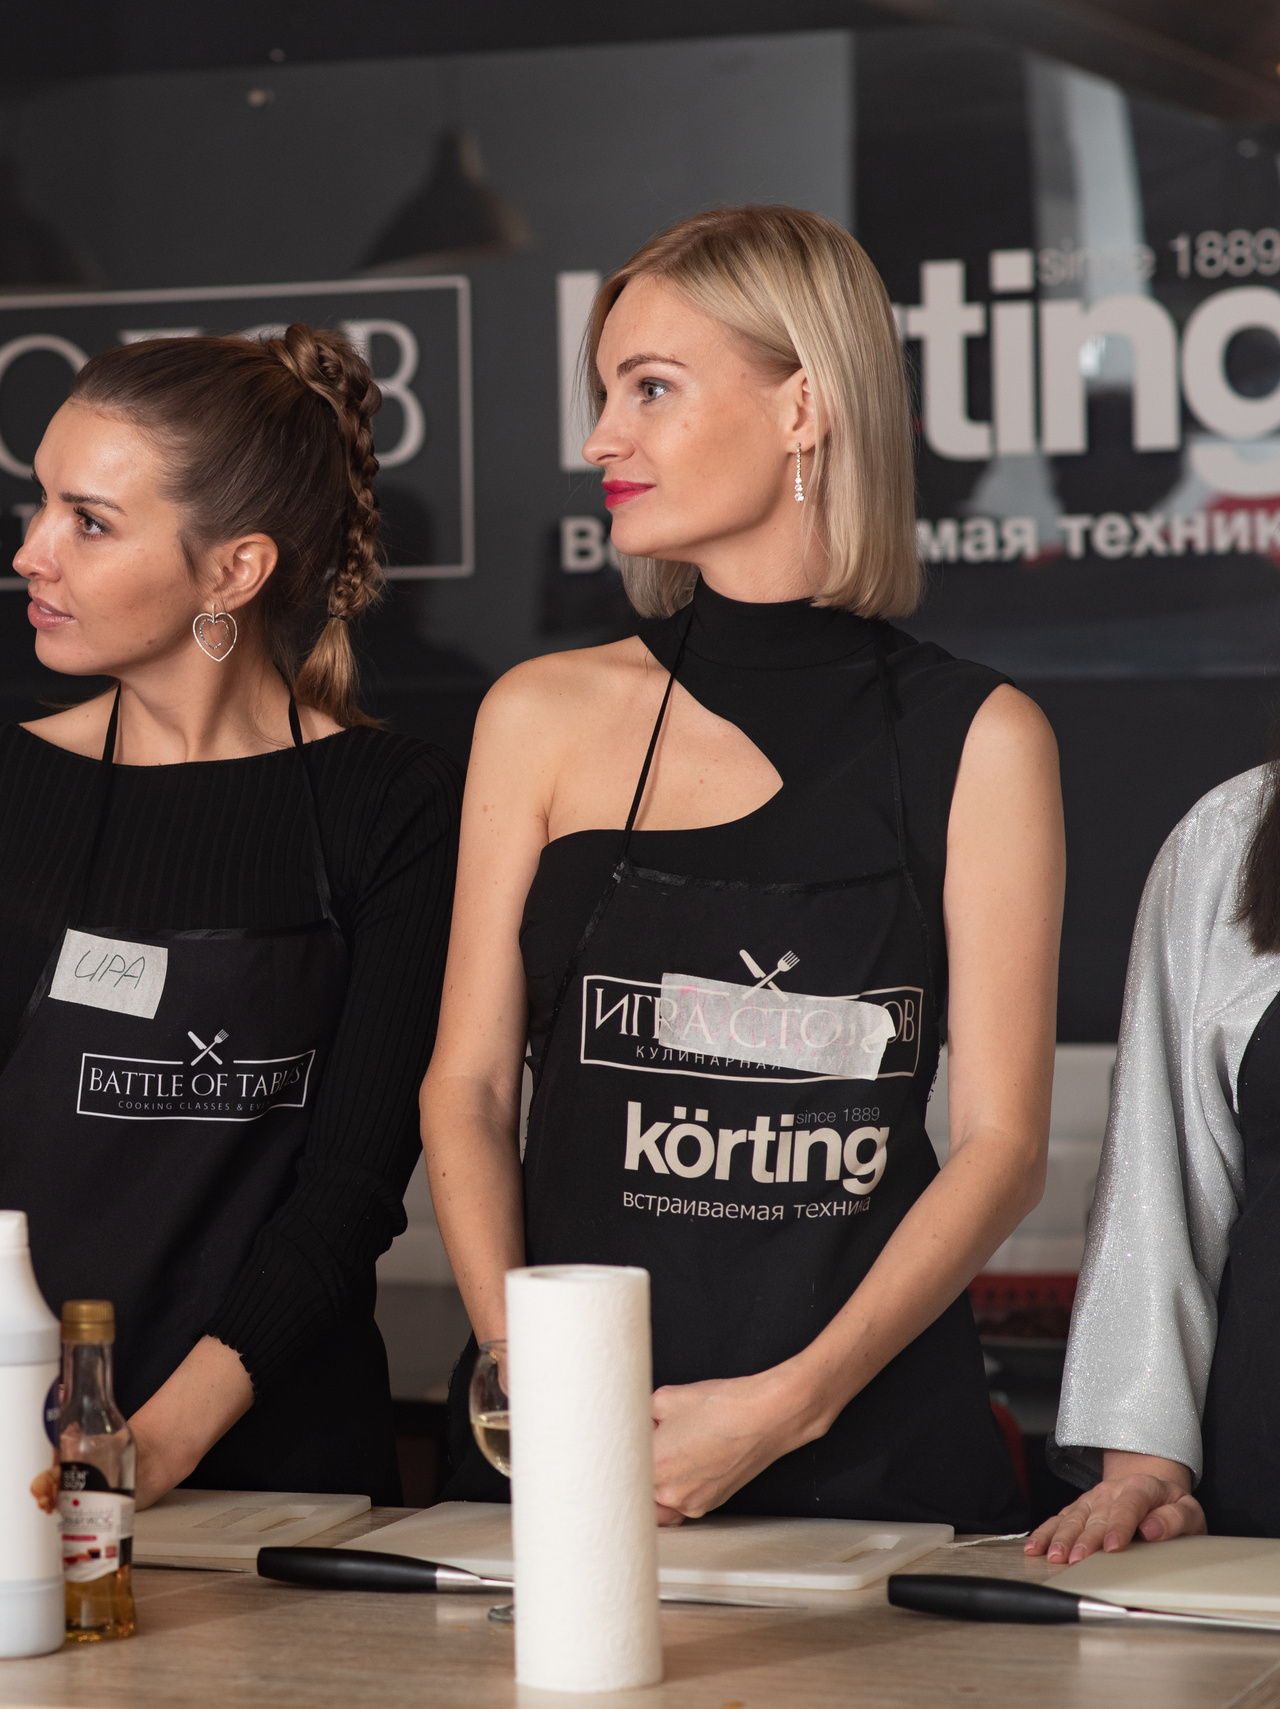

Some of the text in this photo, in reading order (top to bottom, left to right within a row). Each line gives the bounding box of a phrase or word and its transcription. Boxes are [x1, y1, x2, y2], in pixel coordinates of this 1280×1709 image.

[1170, 228, 1280, 279] 1889
[636, 1045, 782, 1071] КУЛИНАРНАЯ
[89, 1067, 184, 1097] BATTLE
[191, 1073, 228, 1097] OF
[118, 1100, 172, 1111] COOKING
[180, 1101, 231, 1111] CLASSES
[796, 1107, 880, 1124] since 1889
[624, 1101, 890, 1195] körting
[623, 1191, 871, 1221] встраиваемая техника
